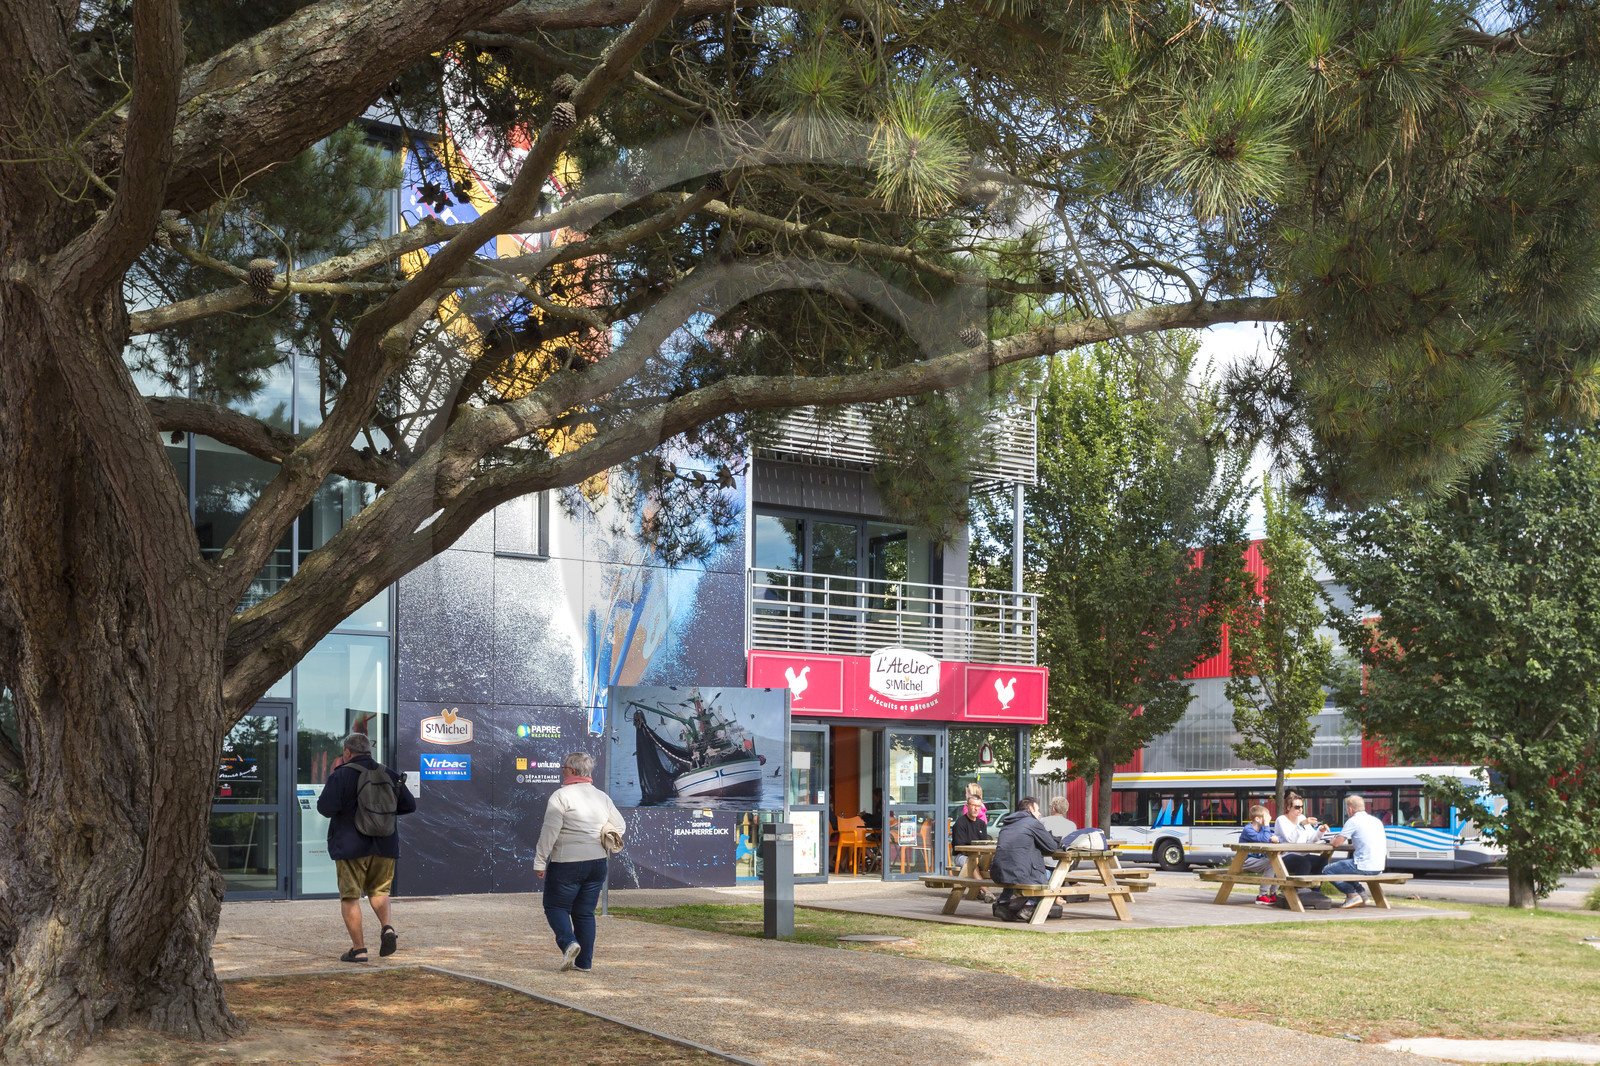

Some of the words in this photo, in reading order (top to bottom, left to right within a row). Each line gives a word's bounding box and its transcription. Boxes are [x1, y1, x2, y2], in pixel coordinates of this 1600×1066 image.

[876, 656, 934, 674] L'Atelier
[868, 694, 898, 710] Biscuits
[910, 698, 939, 712] gâteaux
[424, 758, 467, 768] Virbac
